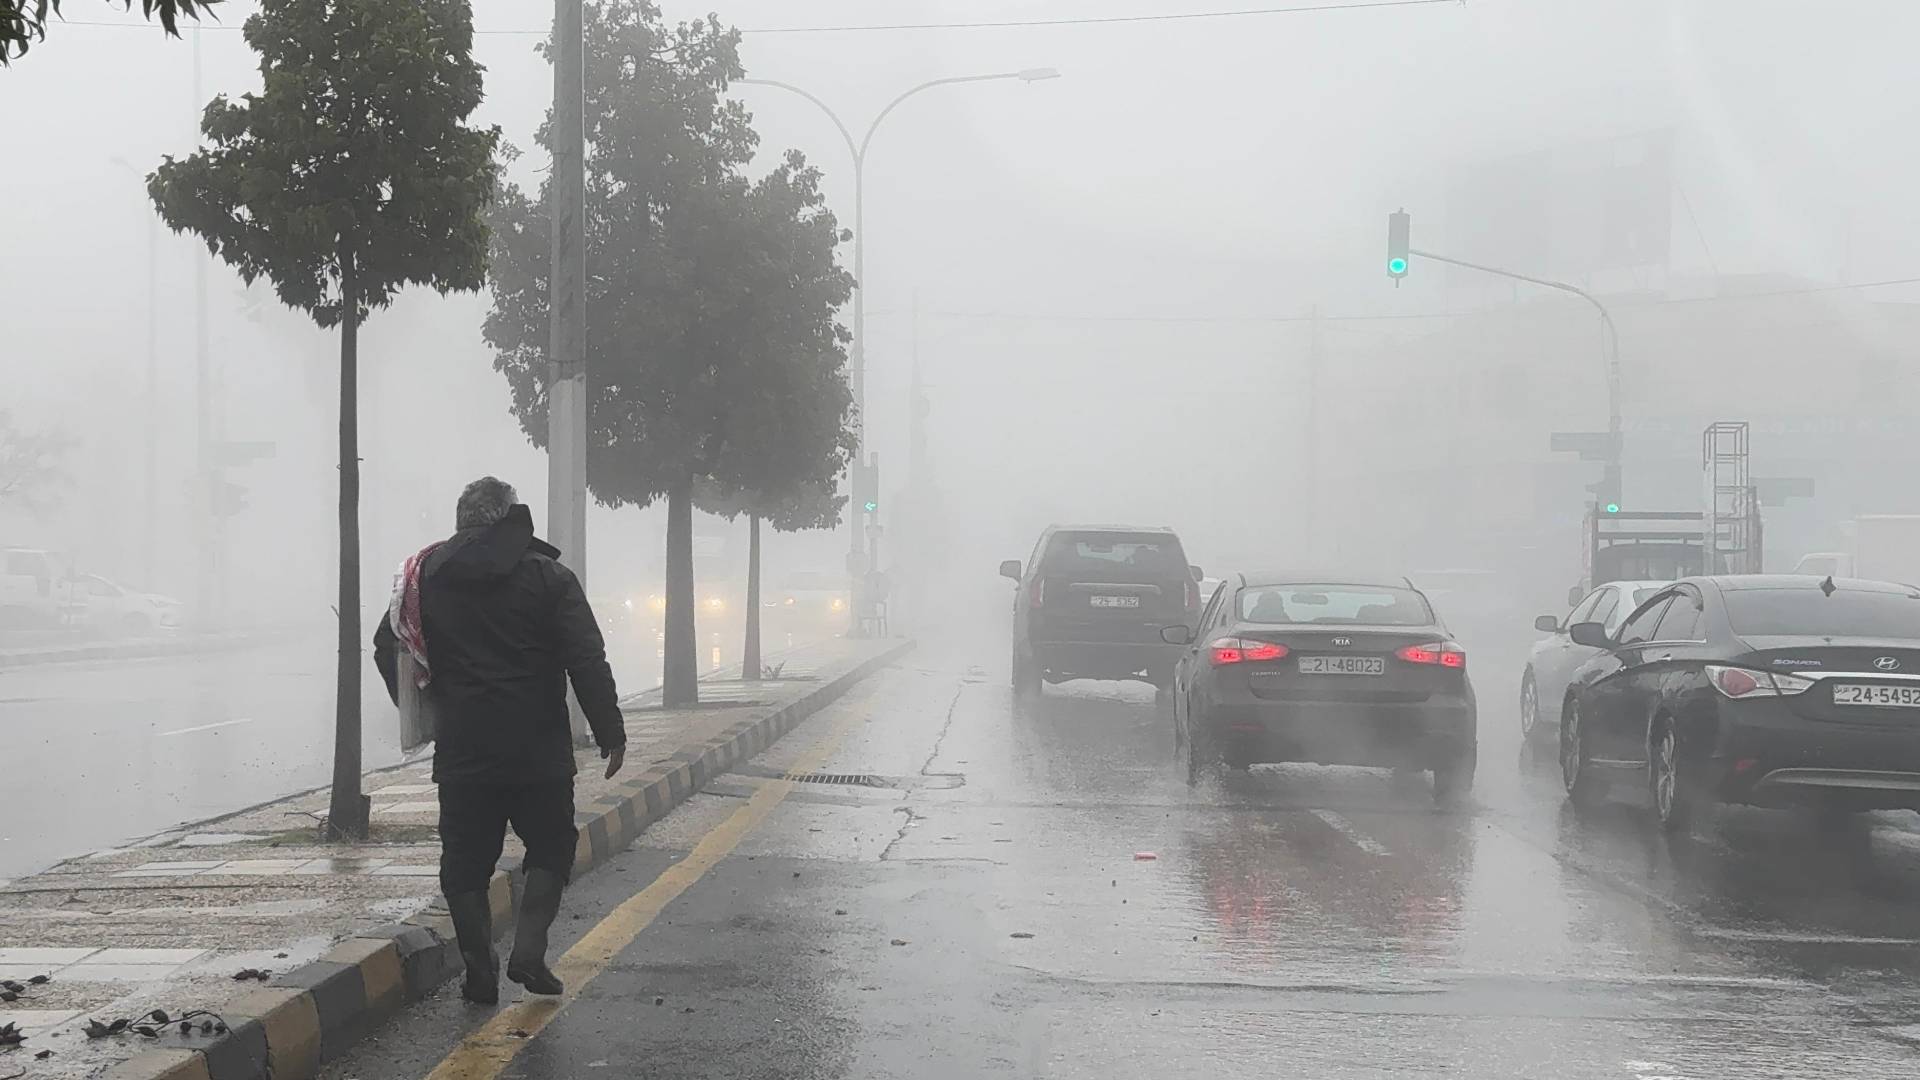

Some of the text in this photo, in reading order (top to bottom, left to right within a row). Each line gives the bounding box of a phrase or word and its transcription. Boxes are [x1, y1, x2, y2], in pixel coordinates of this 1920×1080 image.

[1334, 638, 1351, 646] KIA
[1313, 658, 1382, 673] 21-48023
[1772, 658, 1822, 666] SONATA
[1851, 687, 1920, 704] 24-5492
